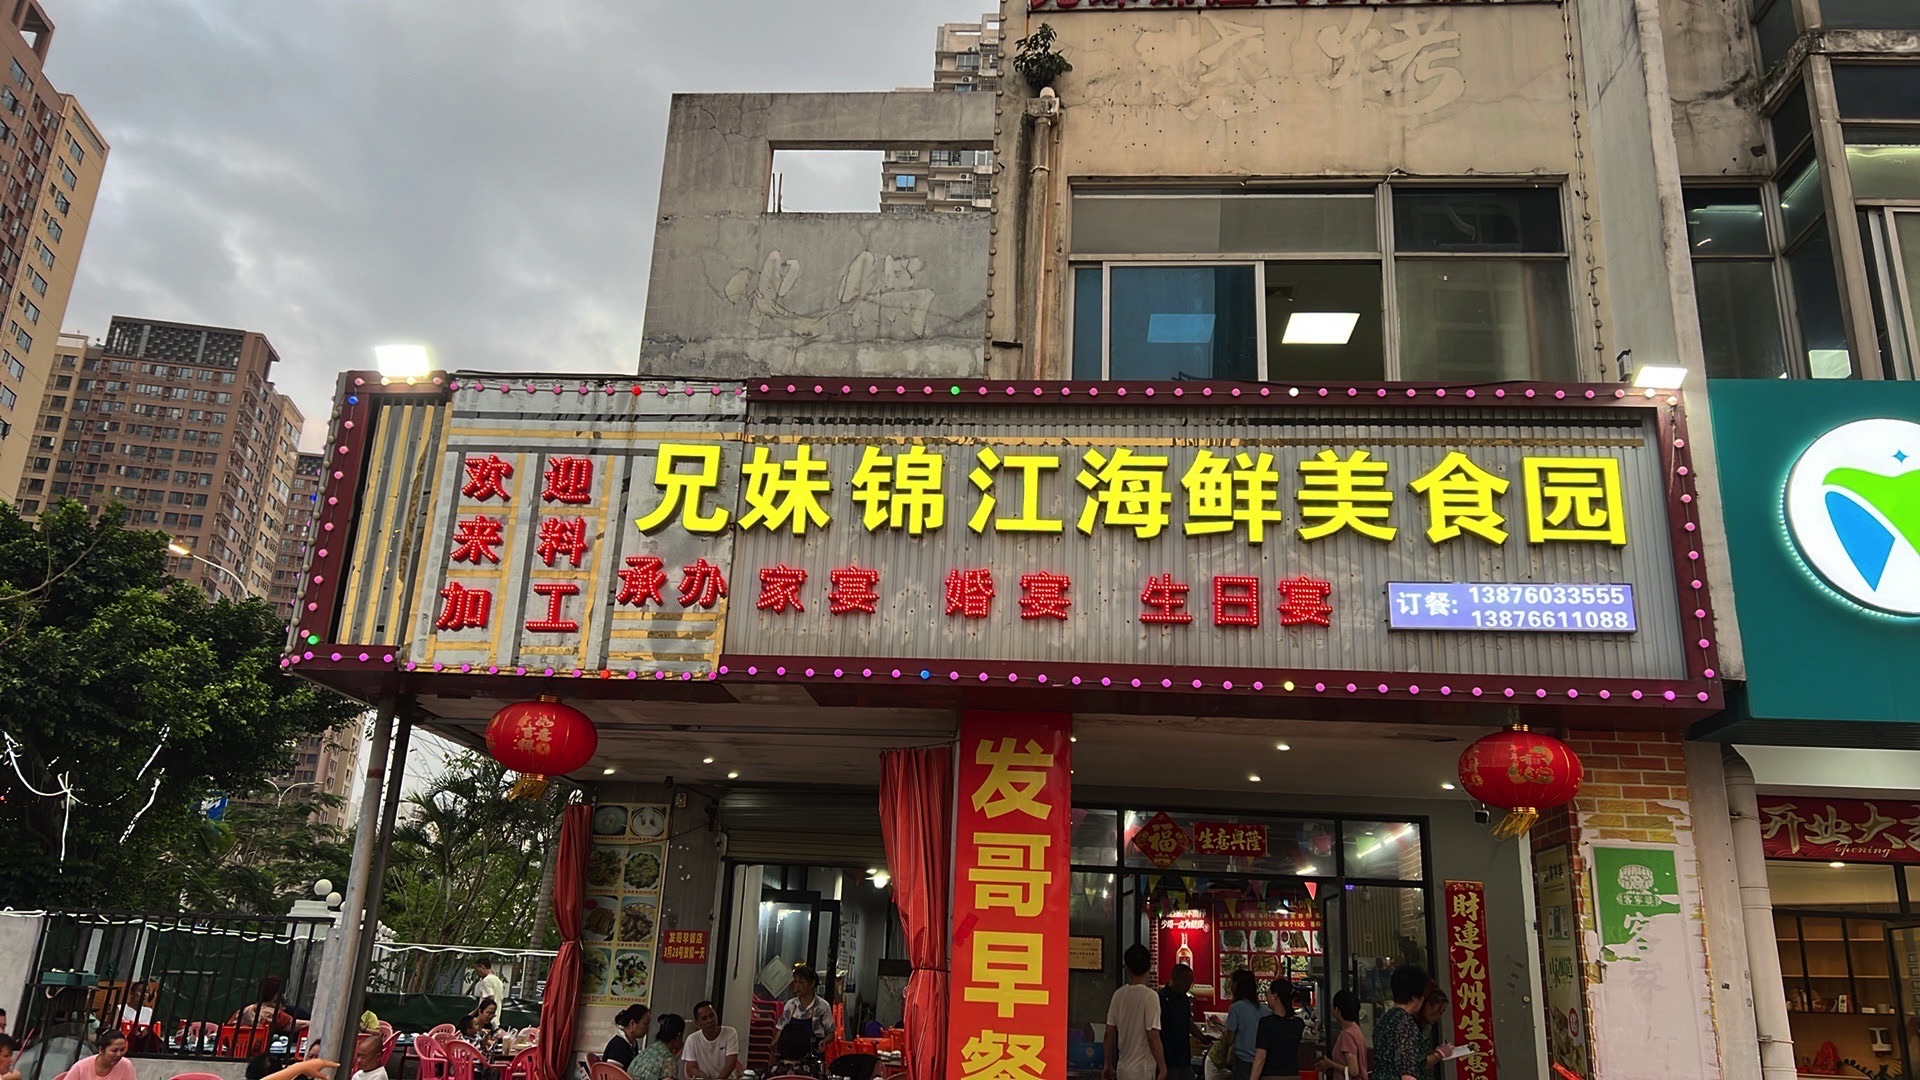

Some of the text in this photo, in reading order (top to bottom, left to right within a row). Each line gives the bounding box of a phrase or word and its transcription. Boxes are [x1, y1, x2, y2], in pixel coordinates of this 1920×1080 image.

[460, 454, 594, 505] 欢迎
[635, 443, 1627, 546] 兄妹锦江海鲜美食园
[450, 514, 589, 568] 来料
[435, 580, 581, 633] 加工
[615, 556, 1333, 628] 承办 家宴 婚宴 生日宴
[1468, 586, 1625, 605] 13876033555
[1471, 610, 1629, 628] 13876611088
[1148, 823, 1178, 852] 福
[1835, 844, 1891, 858] opening
[961, 737, 1054, 1080] 发哥早餐
